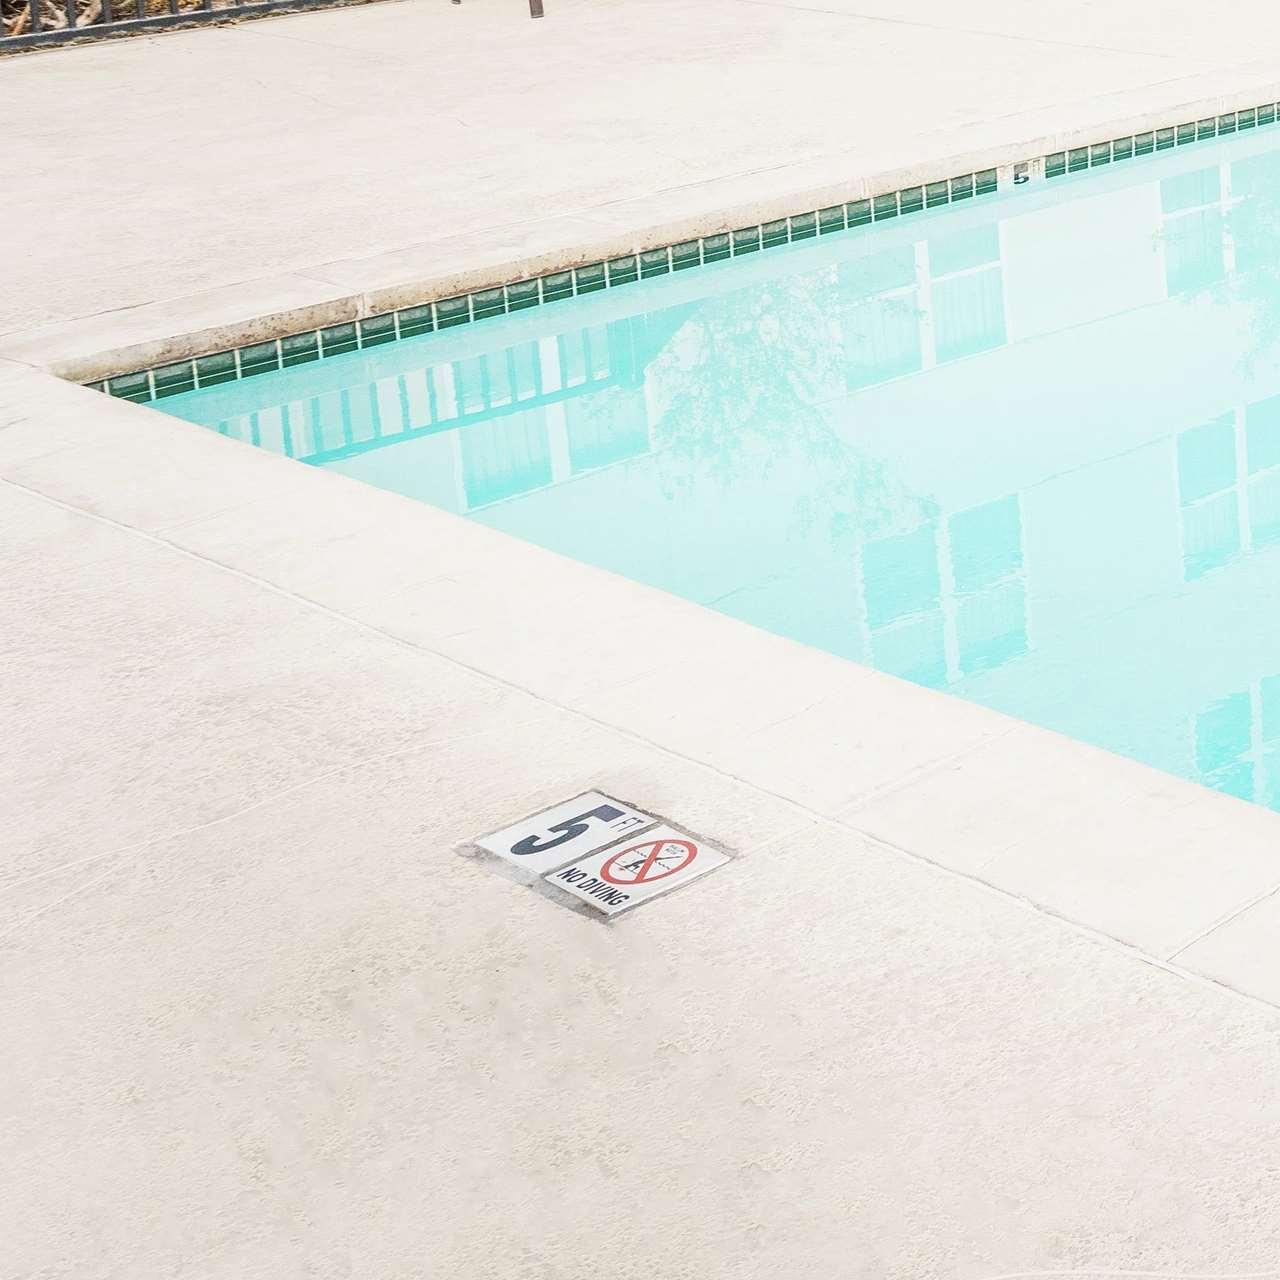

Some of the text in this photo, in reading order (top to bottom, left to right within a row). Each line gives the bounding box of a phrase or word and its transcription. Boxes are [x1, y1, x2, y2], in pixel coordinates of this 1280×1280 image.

[1013, 162, 1029, 185] 5
[510, 803, 645, 856] 5 FT
[556, 866, 632, 907] NO DIVING
